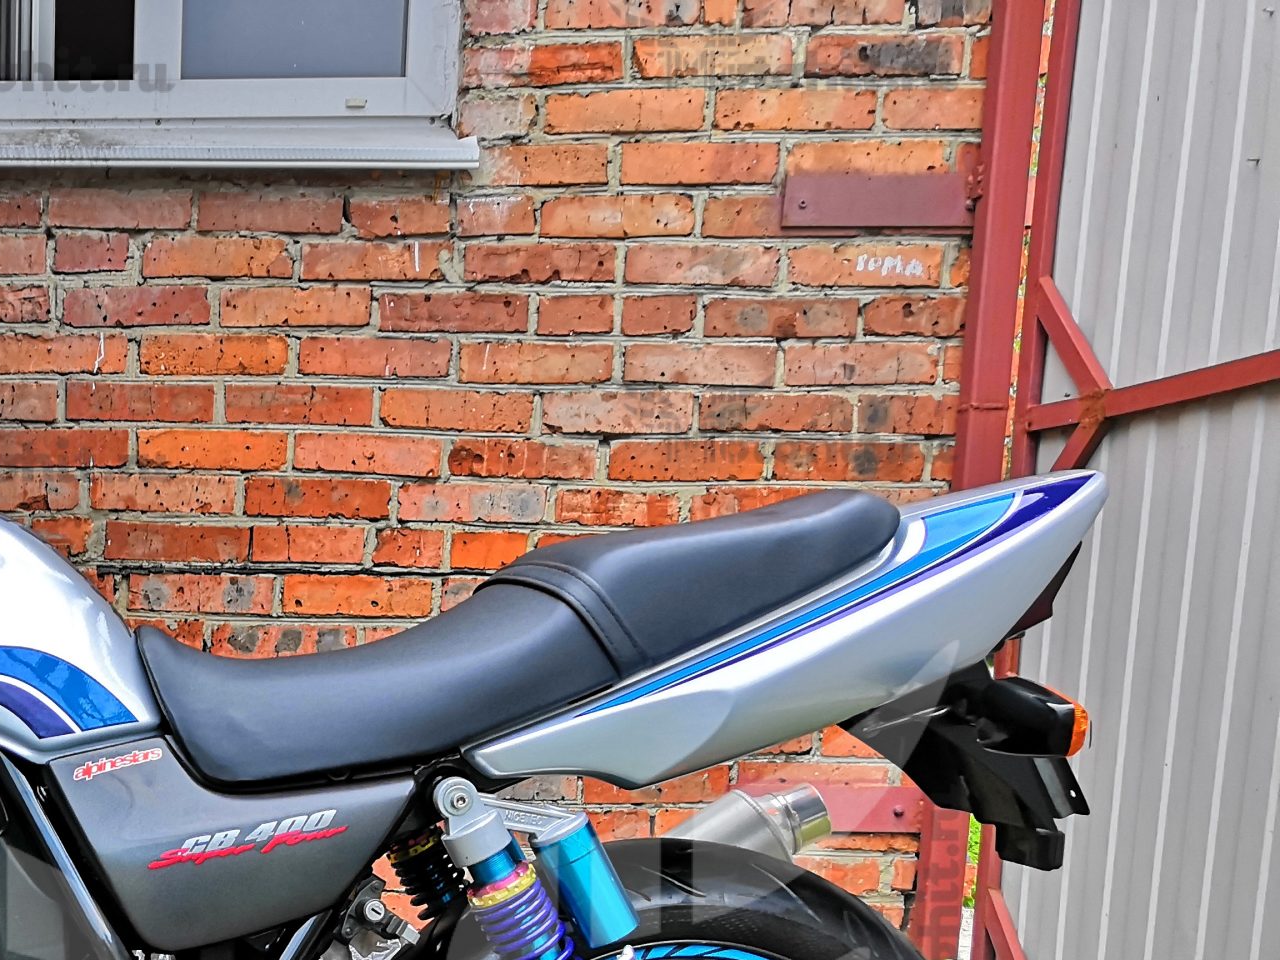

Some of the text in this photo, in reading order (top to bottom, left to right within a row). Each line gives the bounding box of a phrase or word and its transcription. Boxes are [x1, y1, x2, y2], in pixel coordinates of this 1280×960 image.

[73, 747, 162, 781] alpinestars
[179, 809, 337, 855] CB 400
